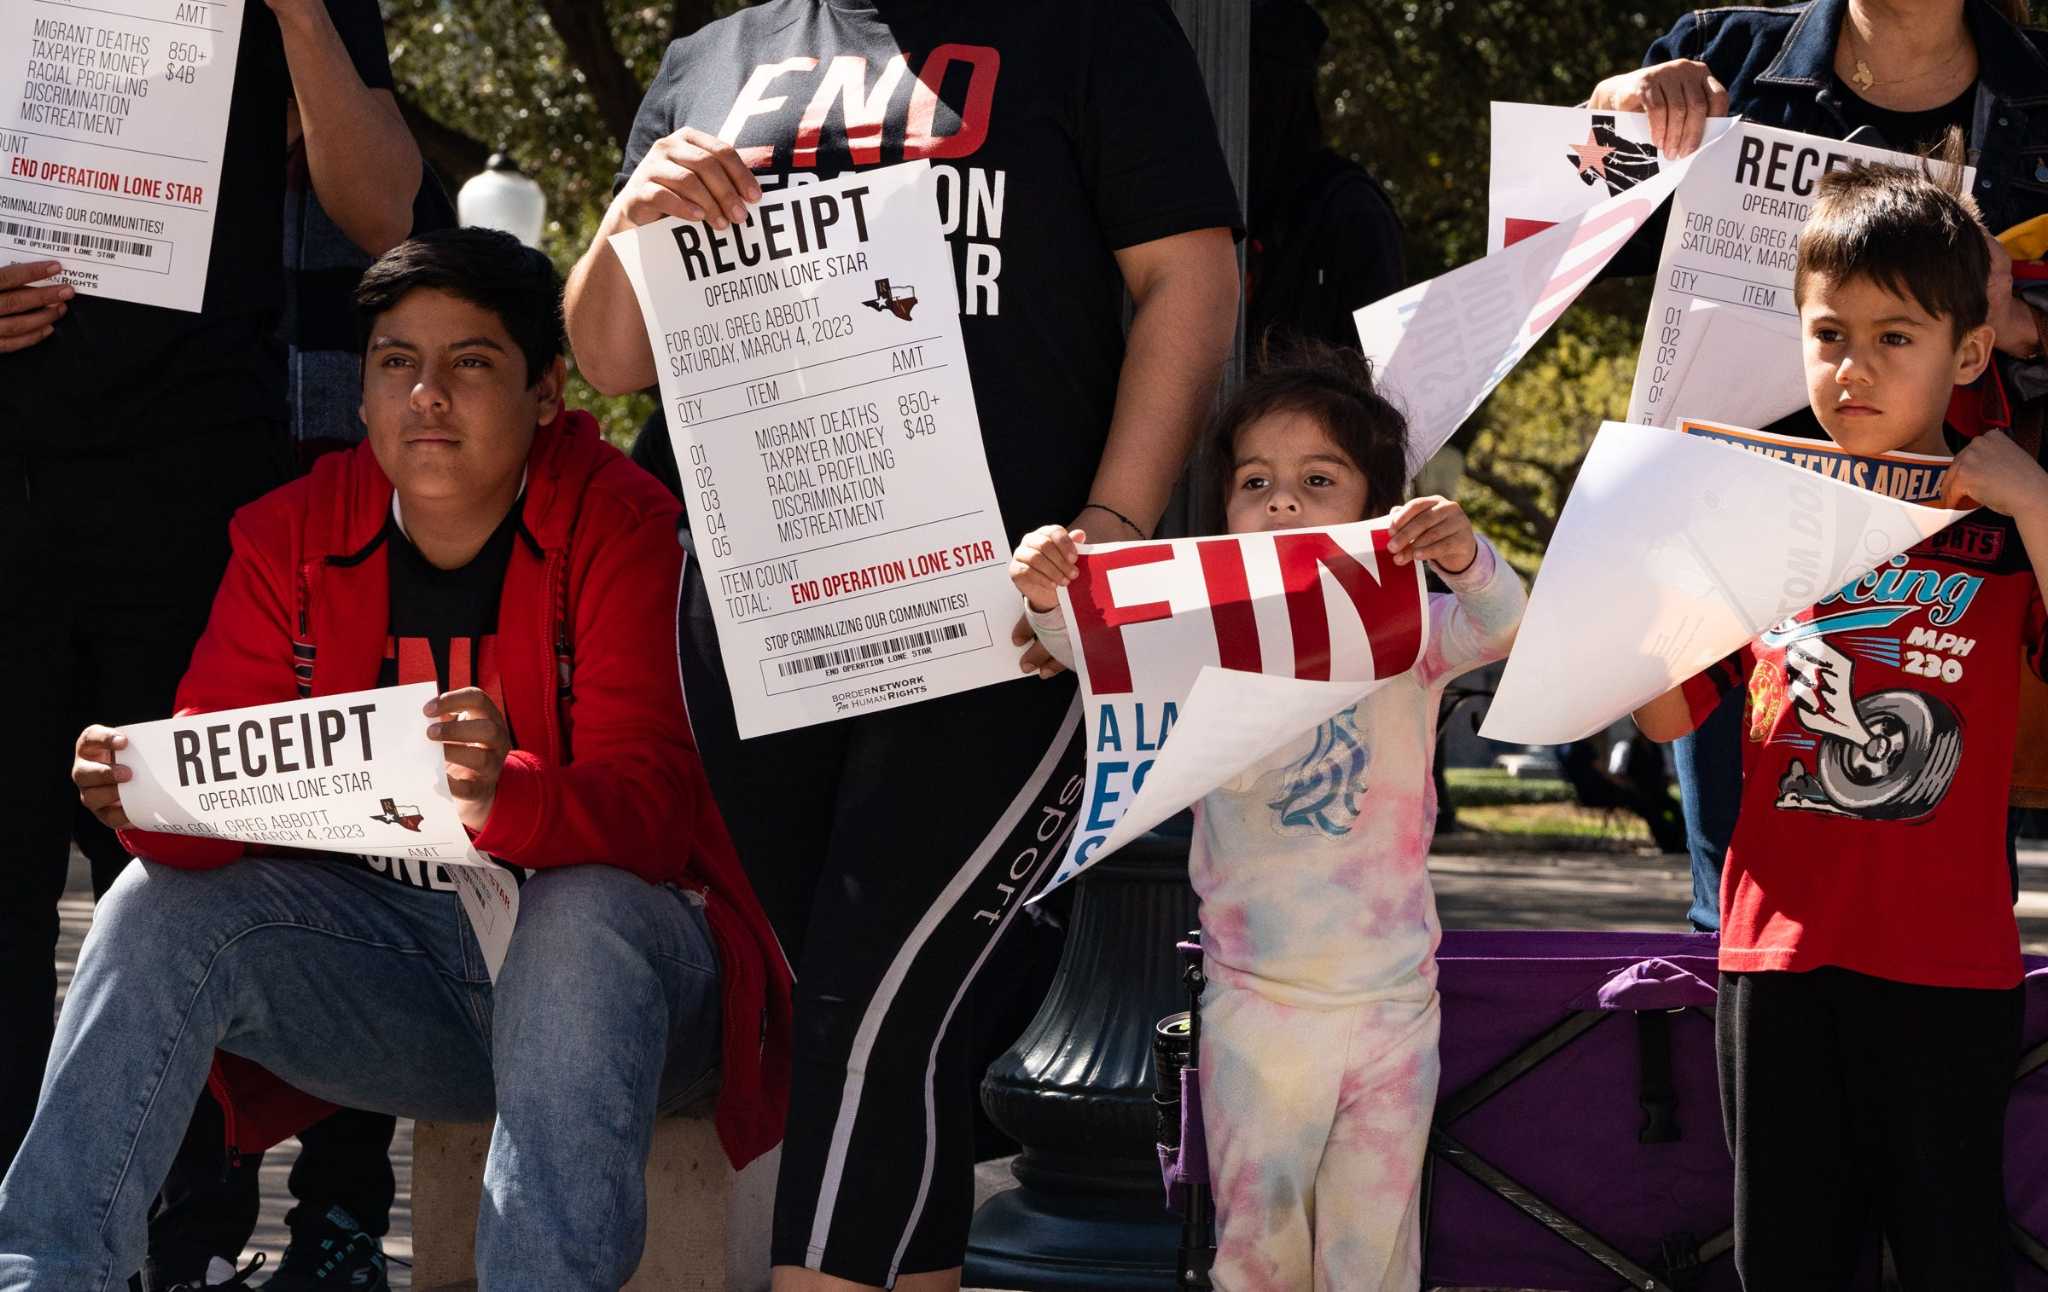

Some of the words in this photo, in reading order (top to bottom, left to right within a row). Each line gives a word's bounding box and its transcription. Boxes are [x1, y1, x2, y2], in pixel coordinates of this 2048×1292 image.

[176, 3, 208, 25] AMT
[33, 18, 94, 45] MIGRANT
[96, 28, 151, 56] DEATHS
[168, 41, 207, 63] 850+
[27, 60, 71, 85] RACIAL
[76, 68, 149, 98] PROFILING
[31, 39, 96, 67] TAXPAYER
[99, 51, 150, 76] MONEY
[165, 62, 196, 84] $4B
[23, 81, 131, 116] DISCRIMINATION
[20, 102, 124, 137] MISTREATMENT
[11, 157, 38, 178] END
[41, 162, 120, 192] OPERATION
[124, 176, 162, 198] LONE
[165, 182, 204, 205] STAR
[0, 195, 63, 219] RIMINALIZING
[66, 207, 87, 222] OUR
[89, 210, 165, 234] COMMUNITIES!
[1742, 194, 1810, 222] OPERATIO
[29, 240, 70, 253] OPERATION
[74, 247, 92, 256] LONE
[97, 251, 116, 260] STAR
[671, 186, 870, 281] RECEIPT
[1685, 212, 1711, 232] FOR
[1716, 219, 1745, 240] GOV.
[1751, 225, 1786, 248] GREG
[1681, 232, 1752, 263] SATURDAY,
[1756, 246, 1797, 271] MARC
[704, 272, 779, 308] OPERATION
[782, 261, 821, 288] LONE
[826, 252, 868, 277] STAR
[1670, 270, 1698, 291] QTY
[1742, 285, 1776, 307] ITEM
[665, 333, 691, 353] FOR
[695, 324, 724, 348] GOV.
[726, 313, 762, 340] GREG
[765, 297, 819, 329] ABBOTT
[1665, 307, 1682, 325] 01
[671, 348, 740, 377] SATURDAY,
[744, 331, 792, 360] MARCH
[795, 327, 811, 347] 4,
[813, 314, 854, 340] 2023
[1657, 346, 1676, 365] 03
[1661, 327, 1680, 346] 02
[677, 400, 703, 423] QTY
[745, 381, 780, 407] ITEM
[891, 346, 925, 372] AMT
[689, 445, 707, 465] 01
[755, 417, 818, 450] MIGRANT
[821, 403, 879, 434] DEATHS
[898, 390, 940, 416] 850+
[695, 467, 713, 488] 02
[760, 439, 829, 473] TAXPAYER
[832, 426, 885, 454] MONEY
[904, 414, 936, 440] $4B
[701, 490, 720, 511] 03
[766, 469, 816, 497] RACIAL
[819, 448, 896, 484] PROFILING
[706, 513, 726, 535] 04
[771, 476, 886, 520] DISCRIMINATION
[712, 536, 731, 558] 05
[777, 500, 886, 543] MISTREATMENT
[720, 571, 755, 595] ITEM
[756, 560, 800, 588] COUNT
[726, 596, 772, 618] TOTAL:
[791, 580, 820, 605] END
[823, 561, 907, 597] OPERATION
[910, 549, 948, 578] LONE
[952, 540, 995, 567] STAR
[764, 632, 789, 652] STOP
[791, 616, 863, 647] CRIMINALIZING
[864, 611, 887, 631] OUR
[889, 593, 969, 624] COMMUNITIES!
[1065, 529, 1422, 695] FIN
[1906, 626, 1976, 656] MPH
[825, 668, 839, 677] END
[842, 657, 884, 673] OPERATION
[888, 653, 907, 662] LONE
[912, 647, 932, 657] STAR
[1903, 651, 1963, 683] 230
[173, 704, 376, 787] RECEIPT
[1097, 703, 1122, 752] A
[198, 787, 284, 812] OPERATION
[289, 779, 329, 799] LONE
[333, 771, 373, 793] STAR
[224, 817, 267, 832] GREG
[271, 809, 331, 829] ABBOTT
[322, 824, 365, 840] 2023
[407, 846, 440, 858] AMT
[973, 774, 1084, 926] sport
